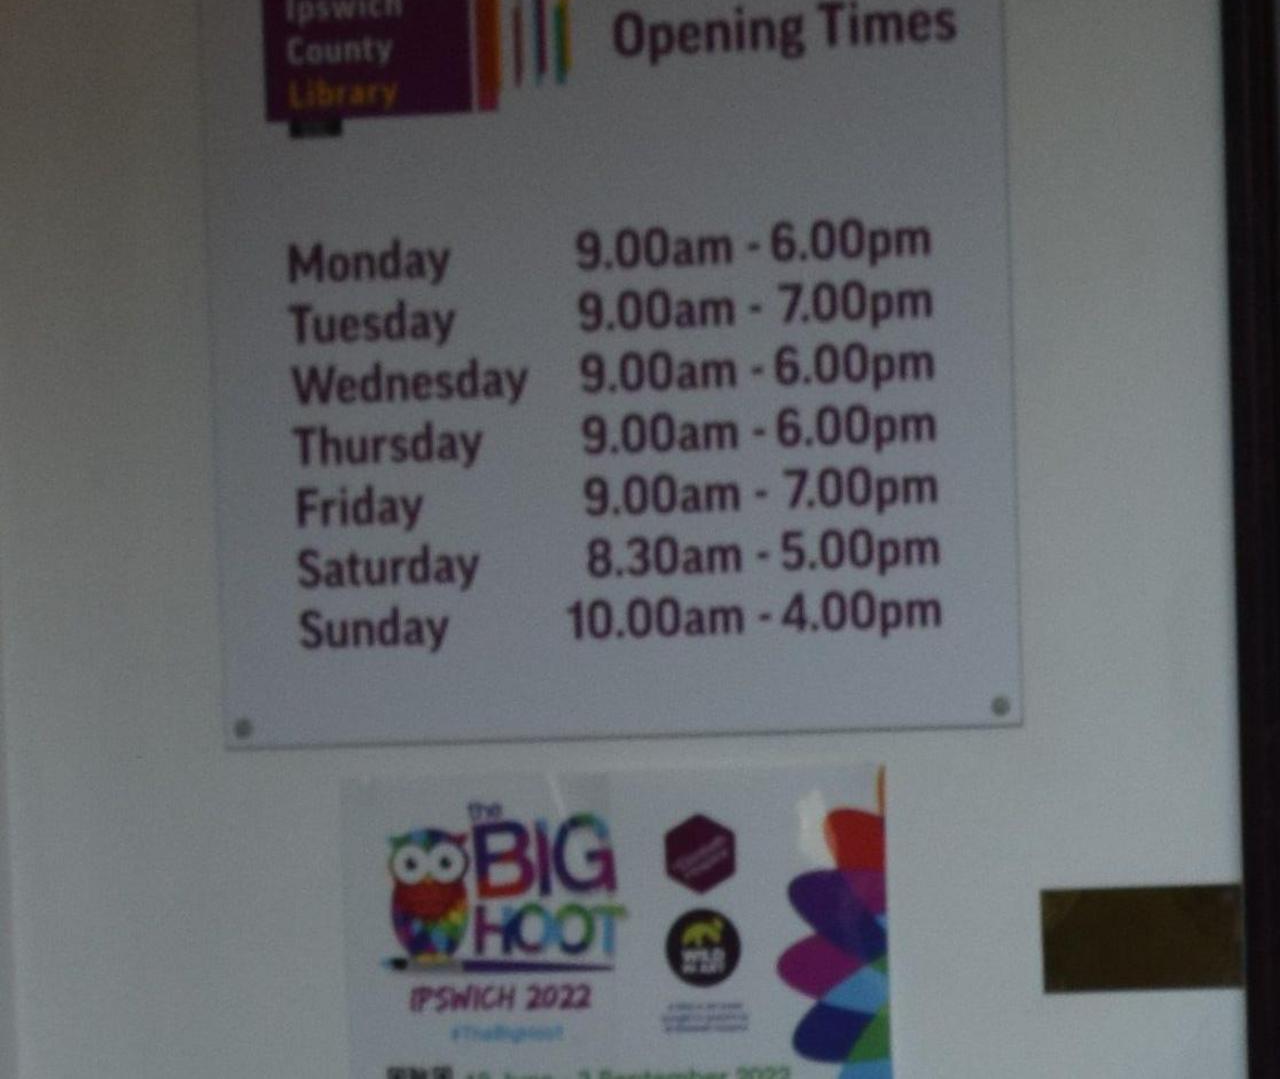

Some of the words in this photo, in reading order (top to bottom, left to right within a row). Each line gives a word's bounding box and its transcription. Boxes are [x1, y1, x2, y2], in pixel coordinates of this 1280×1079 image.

[287, 32, 395, 68] County
[612, 5, 806, 67] Opening
[816, 0, 957, 48] Times
[287, 77, 397, 111] Library
[287, 238, 451, 285] Monday
[575, 226, 733, 272] 9.00am
[770, 217, 931, 267] 6.00pm
[287, 299, 456, 346] Tuesday
[577, 287, 735, 333] 9.00am
[777, 279, 933, 329] 7.00pm
[290, 357, 528, 406] Wednesday
[579, 349, 737, 395] 9.00am
[773, 341, 935, 391] 6.00pm
[291, 420, 483, 468] Thursday
[581, 411, 739, 456] 9.00am
[775, 403, 937, 453] 6.00pm
[295, 484, 424, 532] Friday
[583, 472, 741, 517] 9.00am
[783, 465, 938, 515] 7.00pm
[296, 543, 480, 591] Saturday
[586, 535, 743, 579] 8.30am
[780, 527, 940, 577] 5.00pm
[298, 605, 450, 653] Sunday
[567, 595, 745, 640] 10.00am
[781, 588, 942, 638] 4.00pm
[468, 802, 502, 820] the
[473, 812, 617, 899] BIG
[473, 903, 627, 954] HOOT
[410, 987, 515, 1012] IPSWICH
[526, 985, 593, 1010] 2022
